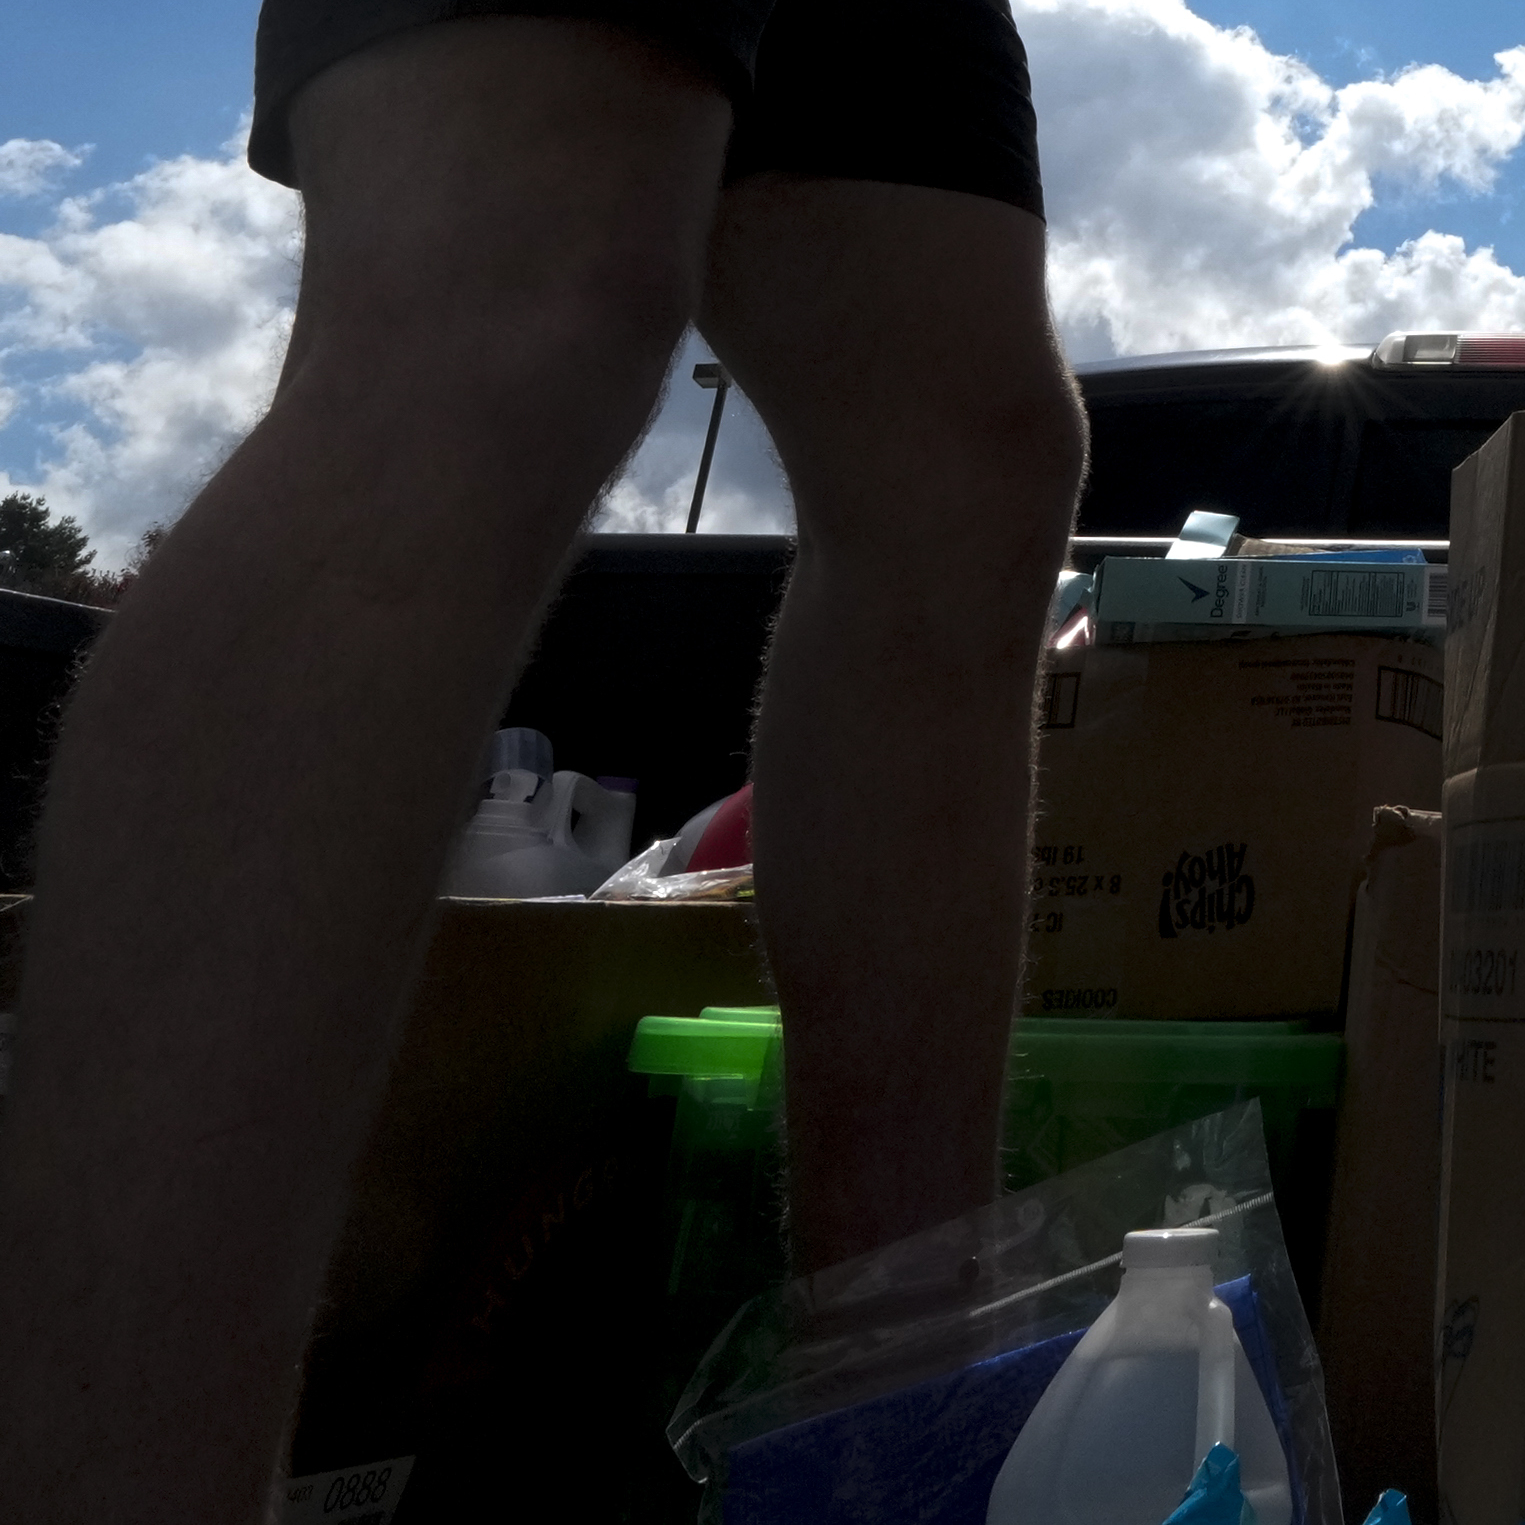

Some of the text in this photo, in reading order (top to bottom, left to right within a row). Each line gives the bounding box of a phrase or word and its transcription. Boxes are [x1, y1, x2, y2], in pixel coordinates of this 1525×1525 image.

[1209, 564, 1230, 619] Degree
[1062, 845, 1085, 866] 19
[1092, 876, 1105, 892] x
[1108, 874, 1123, 896] 8
[1041, 988, 1119, 1012] COOKIES
[322, 1466, 392, 1514] 0888
